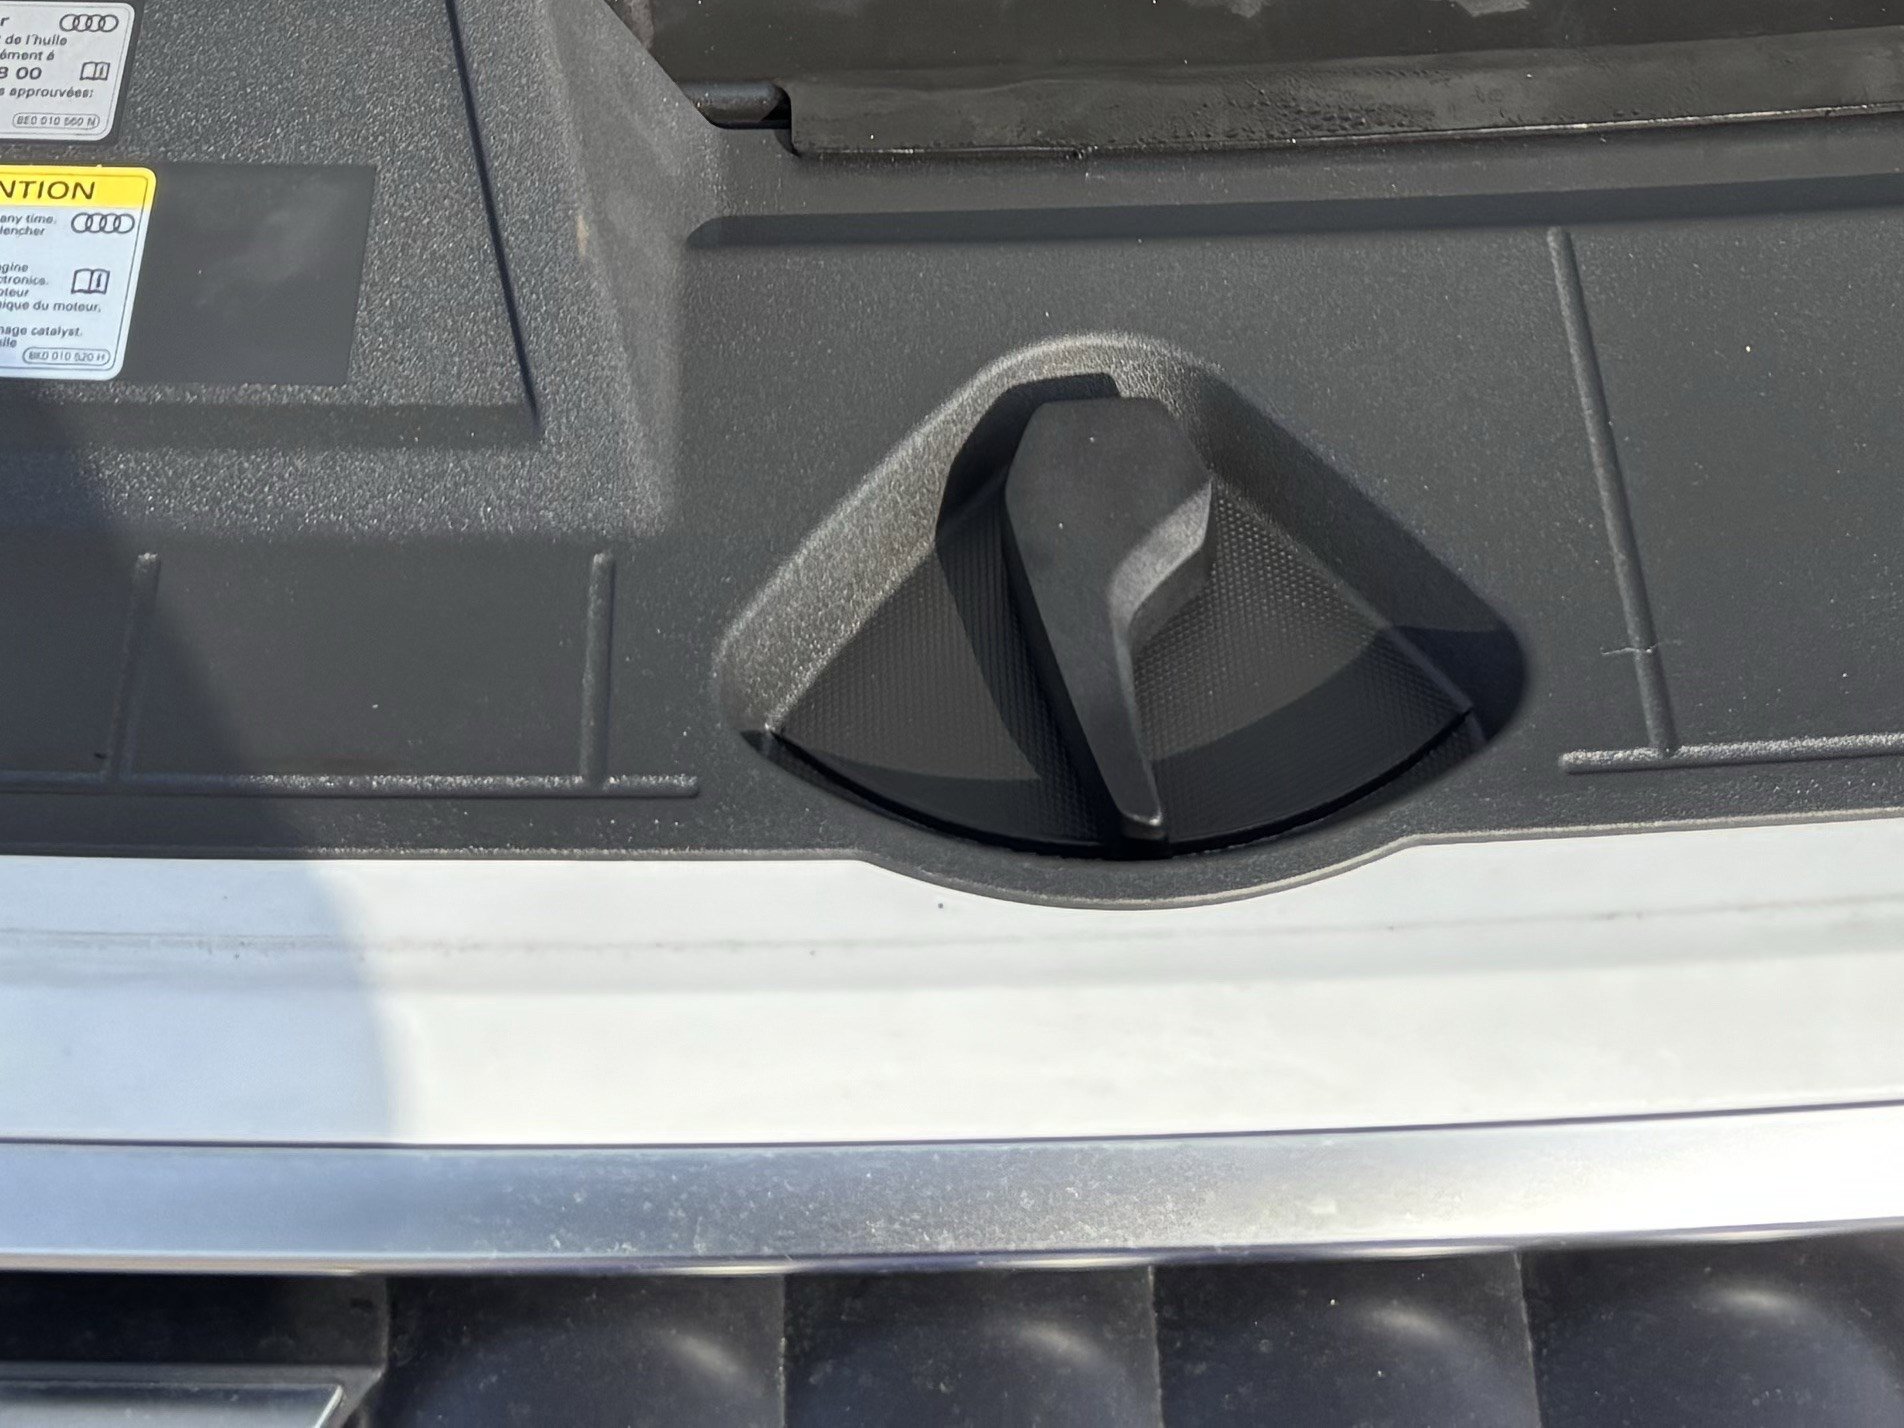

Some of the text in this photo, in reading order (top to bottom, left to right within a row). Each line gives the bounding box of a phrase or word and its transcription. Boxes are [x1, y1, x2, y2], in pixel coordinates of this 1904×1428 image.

[5, 33, 22, 45] de
[15, 66, 43, 80] 00
[0, 214, 22, 226] any
[33, 300, 49, 311] du
